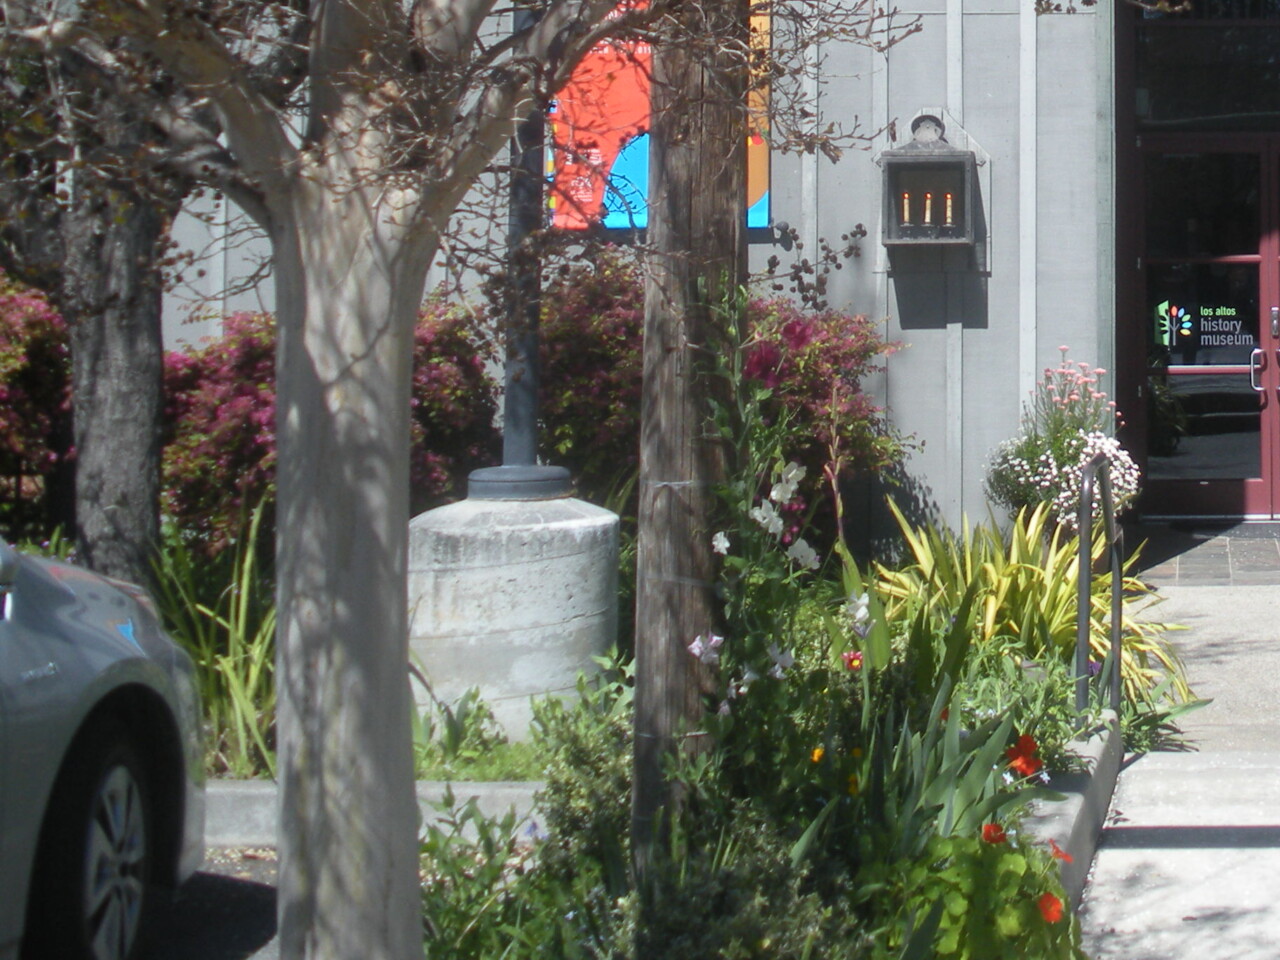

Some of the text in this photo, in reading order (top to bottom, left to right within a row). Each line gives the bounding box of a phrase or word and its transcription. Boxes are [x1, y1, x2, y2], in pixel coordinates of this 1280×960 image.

[1200, 306, 1236, 316] los altos
[1200, 317, 1242, 334] history
[1200, 334, 1254, 346] museum
